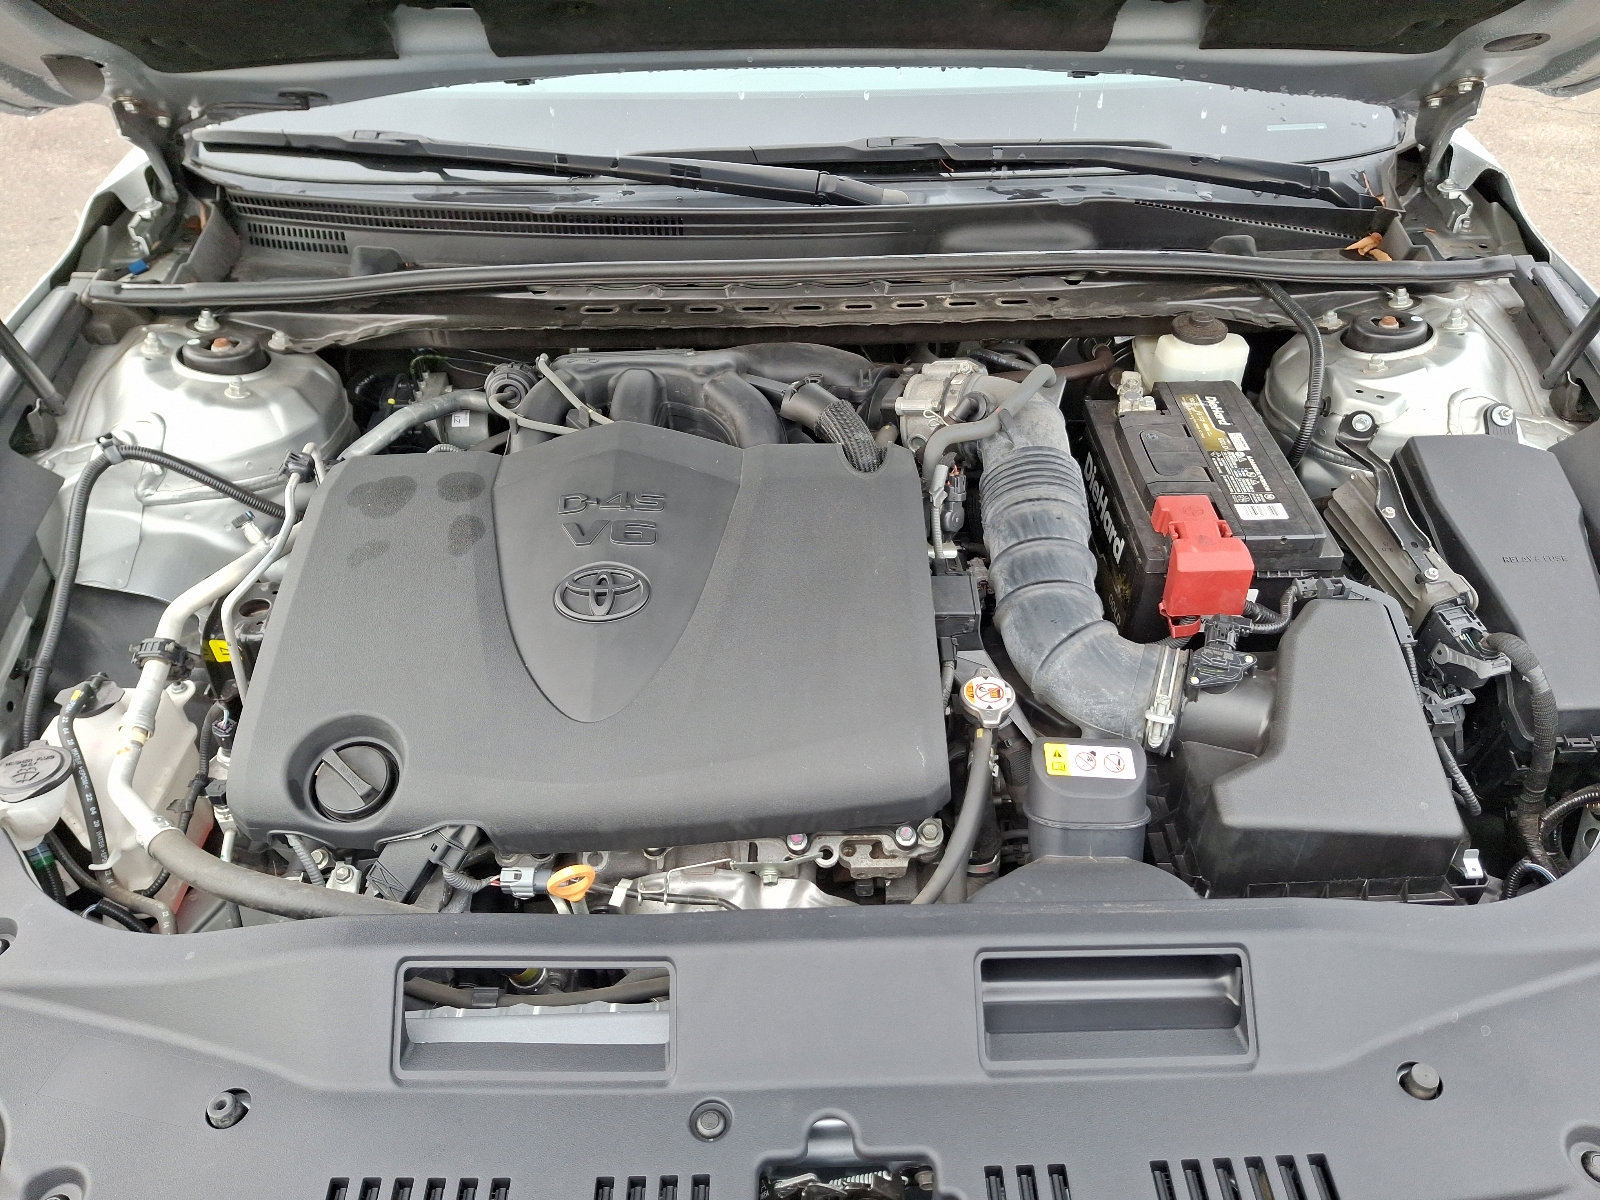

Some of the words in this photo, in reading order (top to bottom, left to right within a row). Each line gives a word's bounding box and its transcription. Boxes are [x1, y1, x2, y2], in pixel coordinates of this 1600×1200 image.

[1204, 395, 1233, 426] DieHard
[558, 491, 665, 515] D-4S
[1083, 451, 1125, 565] DieHard
[561, 519, 657, 547] V6
[85, 793, 93, 802] 22
[89, 806, 97, 815] 04
